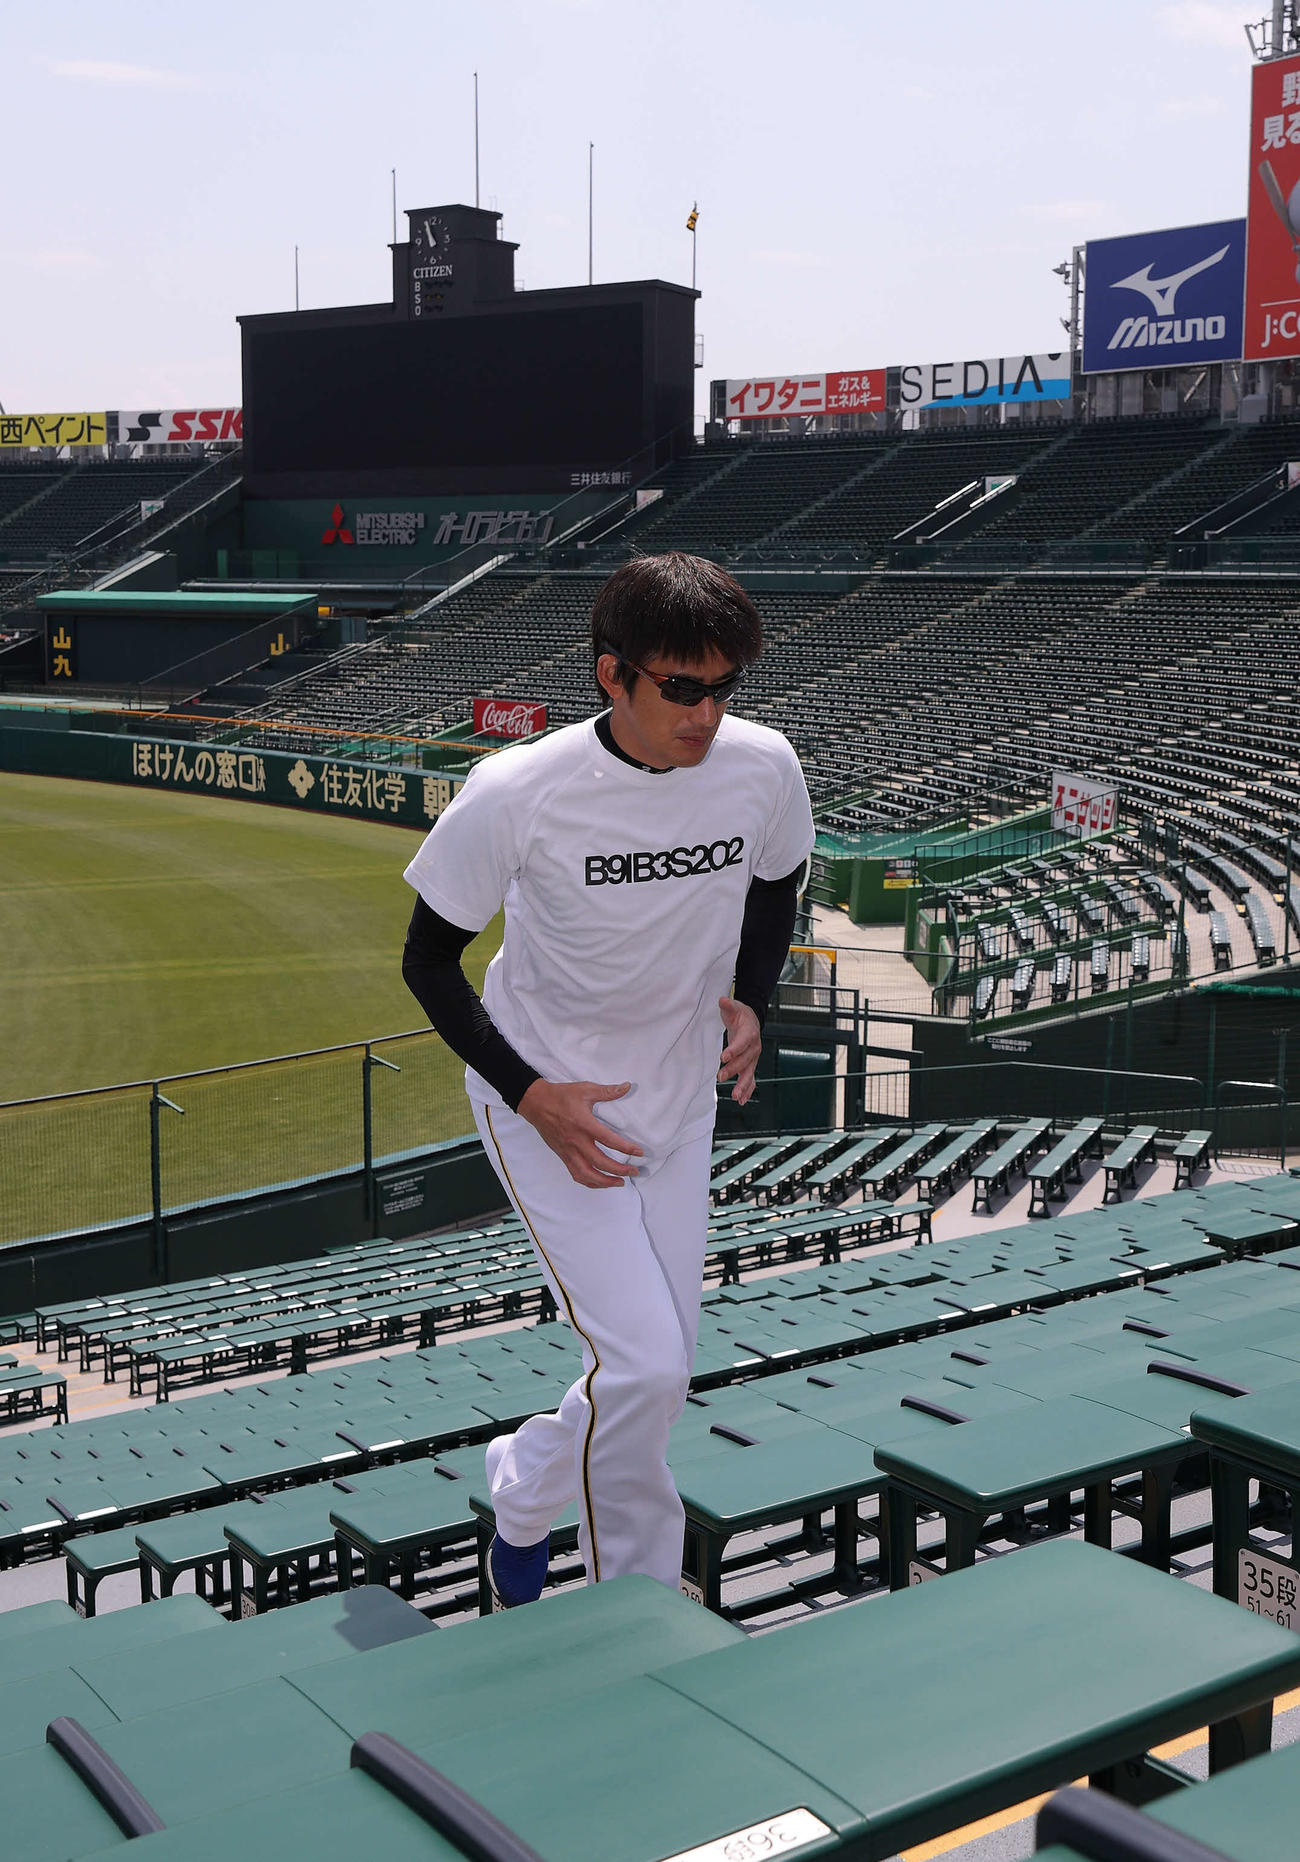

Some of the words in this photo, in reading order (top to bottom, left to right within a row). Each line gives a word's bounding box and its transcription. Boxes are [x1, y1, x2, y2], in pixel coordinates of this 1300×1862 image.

[413, 264, 453, 279] CITIZEN
[414, 281, 420, 292] B
[414, 293, 421, 304] S
[1261, 311, 1300, 348] J:C
[730, 379, 823, 413] イワタニ
[828, 391, 882, 408] エネルギー
[356, 513, 424, 529] MITSUBISHI
[356, 529, 416, 544] ELECTRIC
[53, 627, 72, 677] 山九
[482, 702, 534, 735] Coca-Cola
[319, 763, 406, 813] 住友化学
[423, 776, 466, 819] 朝
[1243, 1561, 1297, 1611] 35段
